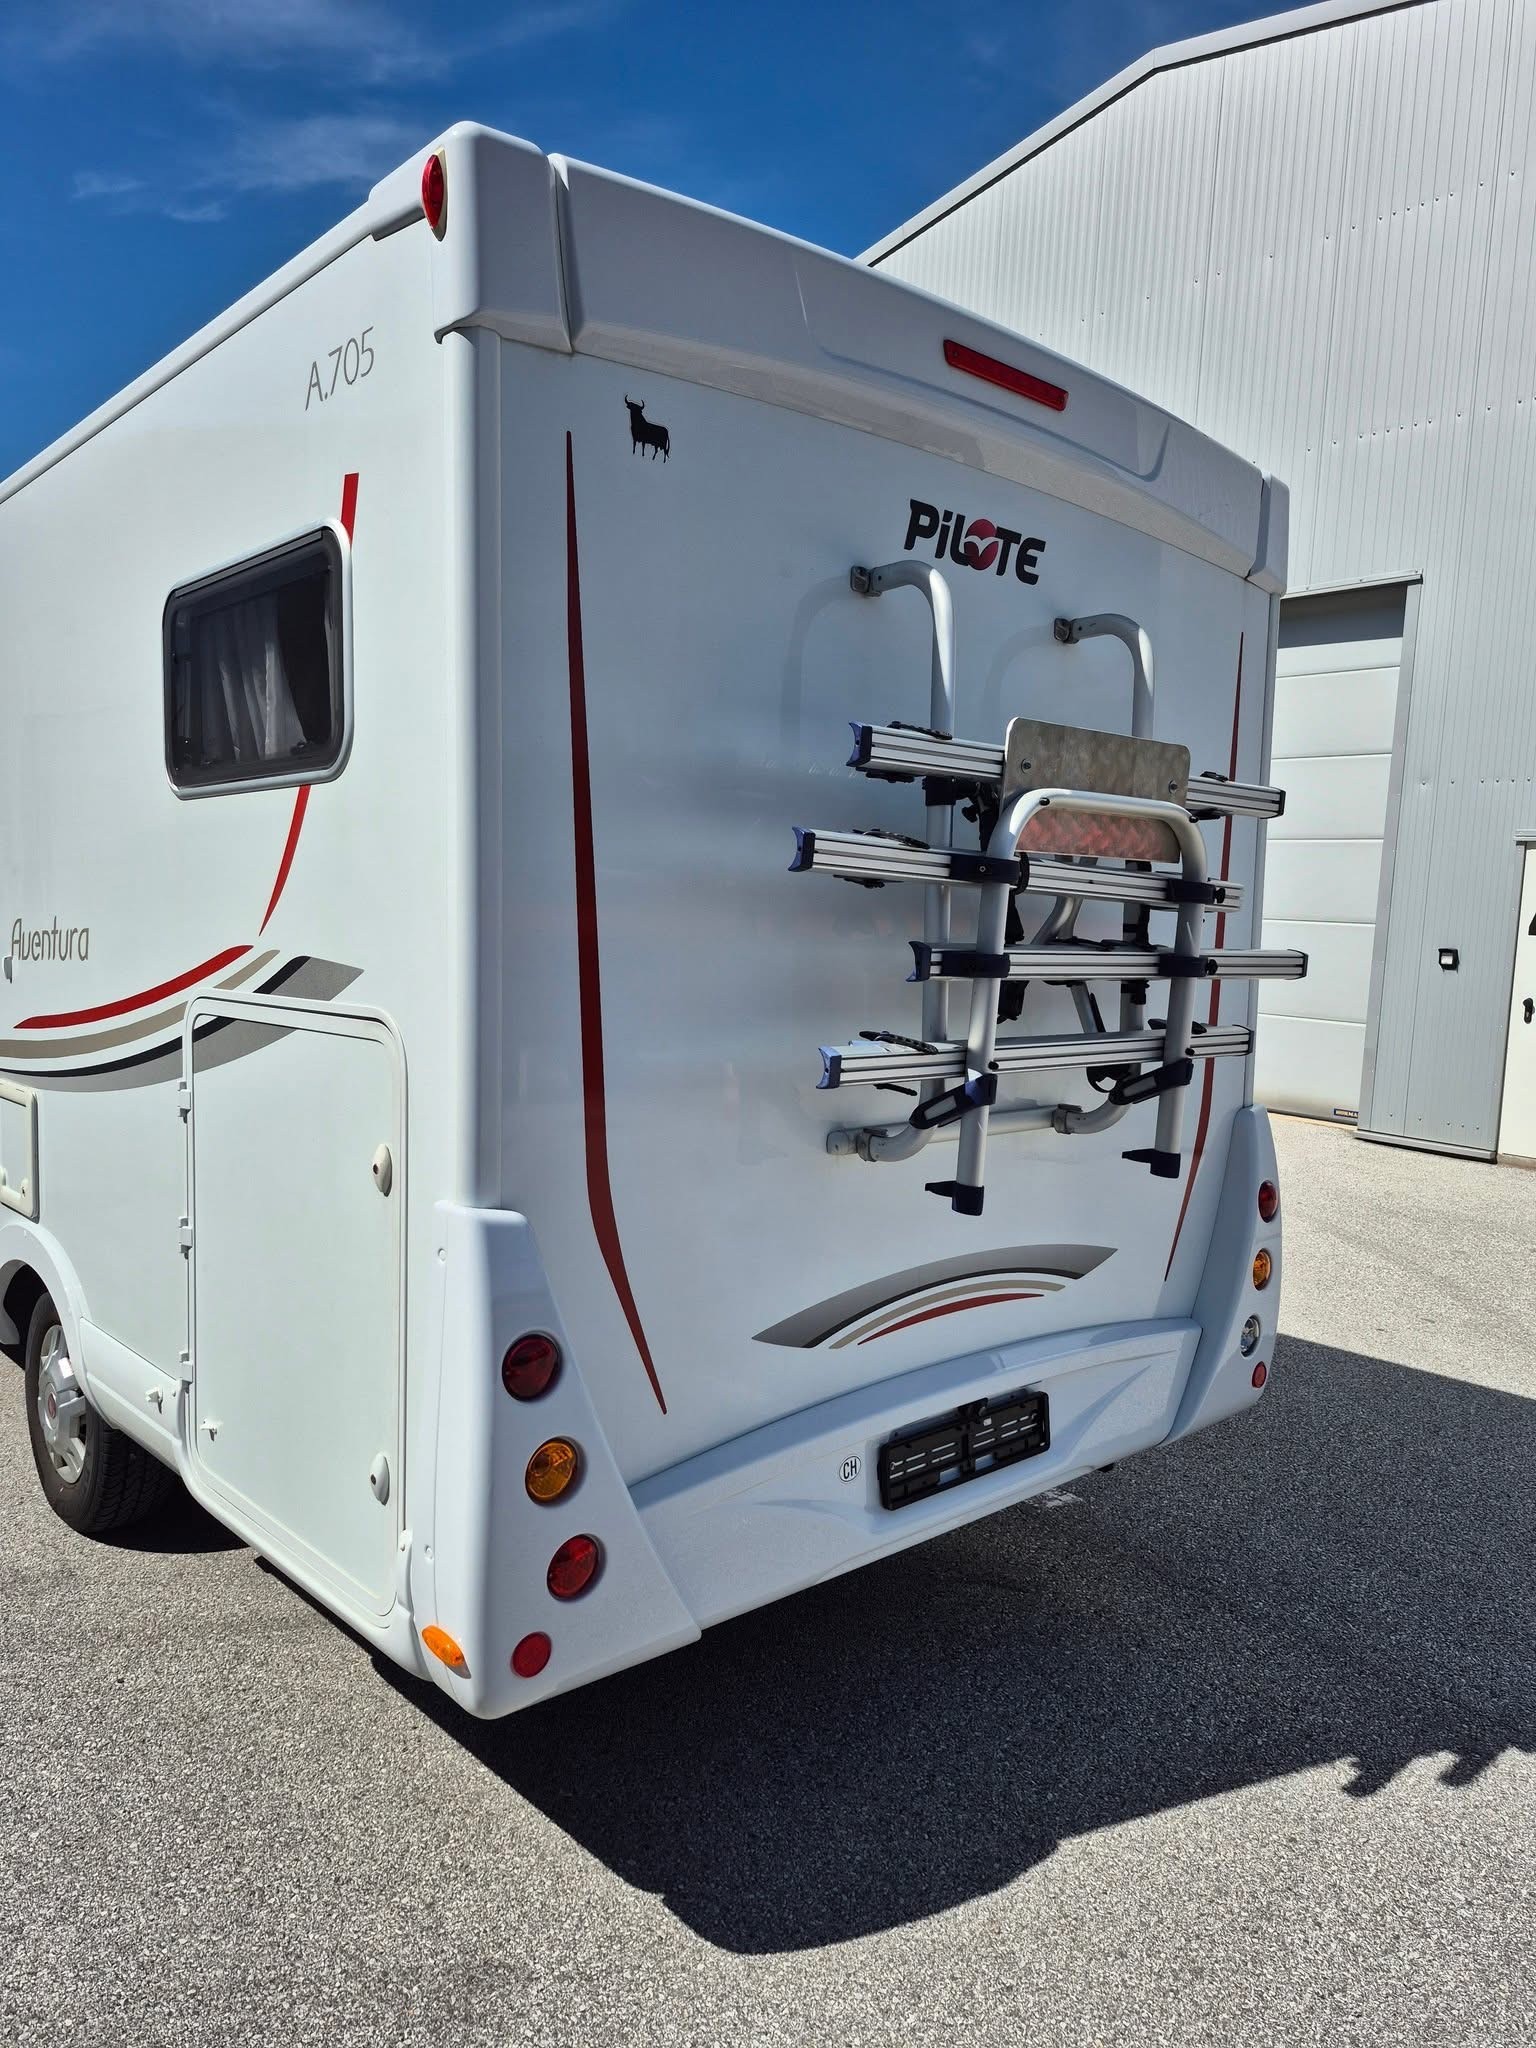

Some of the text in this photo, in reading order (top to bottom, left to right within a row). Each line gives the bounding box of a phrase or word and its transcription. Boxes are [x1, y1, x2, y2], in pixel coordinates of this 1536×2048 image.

[305, 325, 374, 411] A.705
[11, 915, 89, 961] Aventura
[843, 1458, 857, 1479] CH
